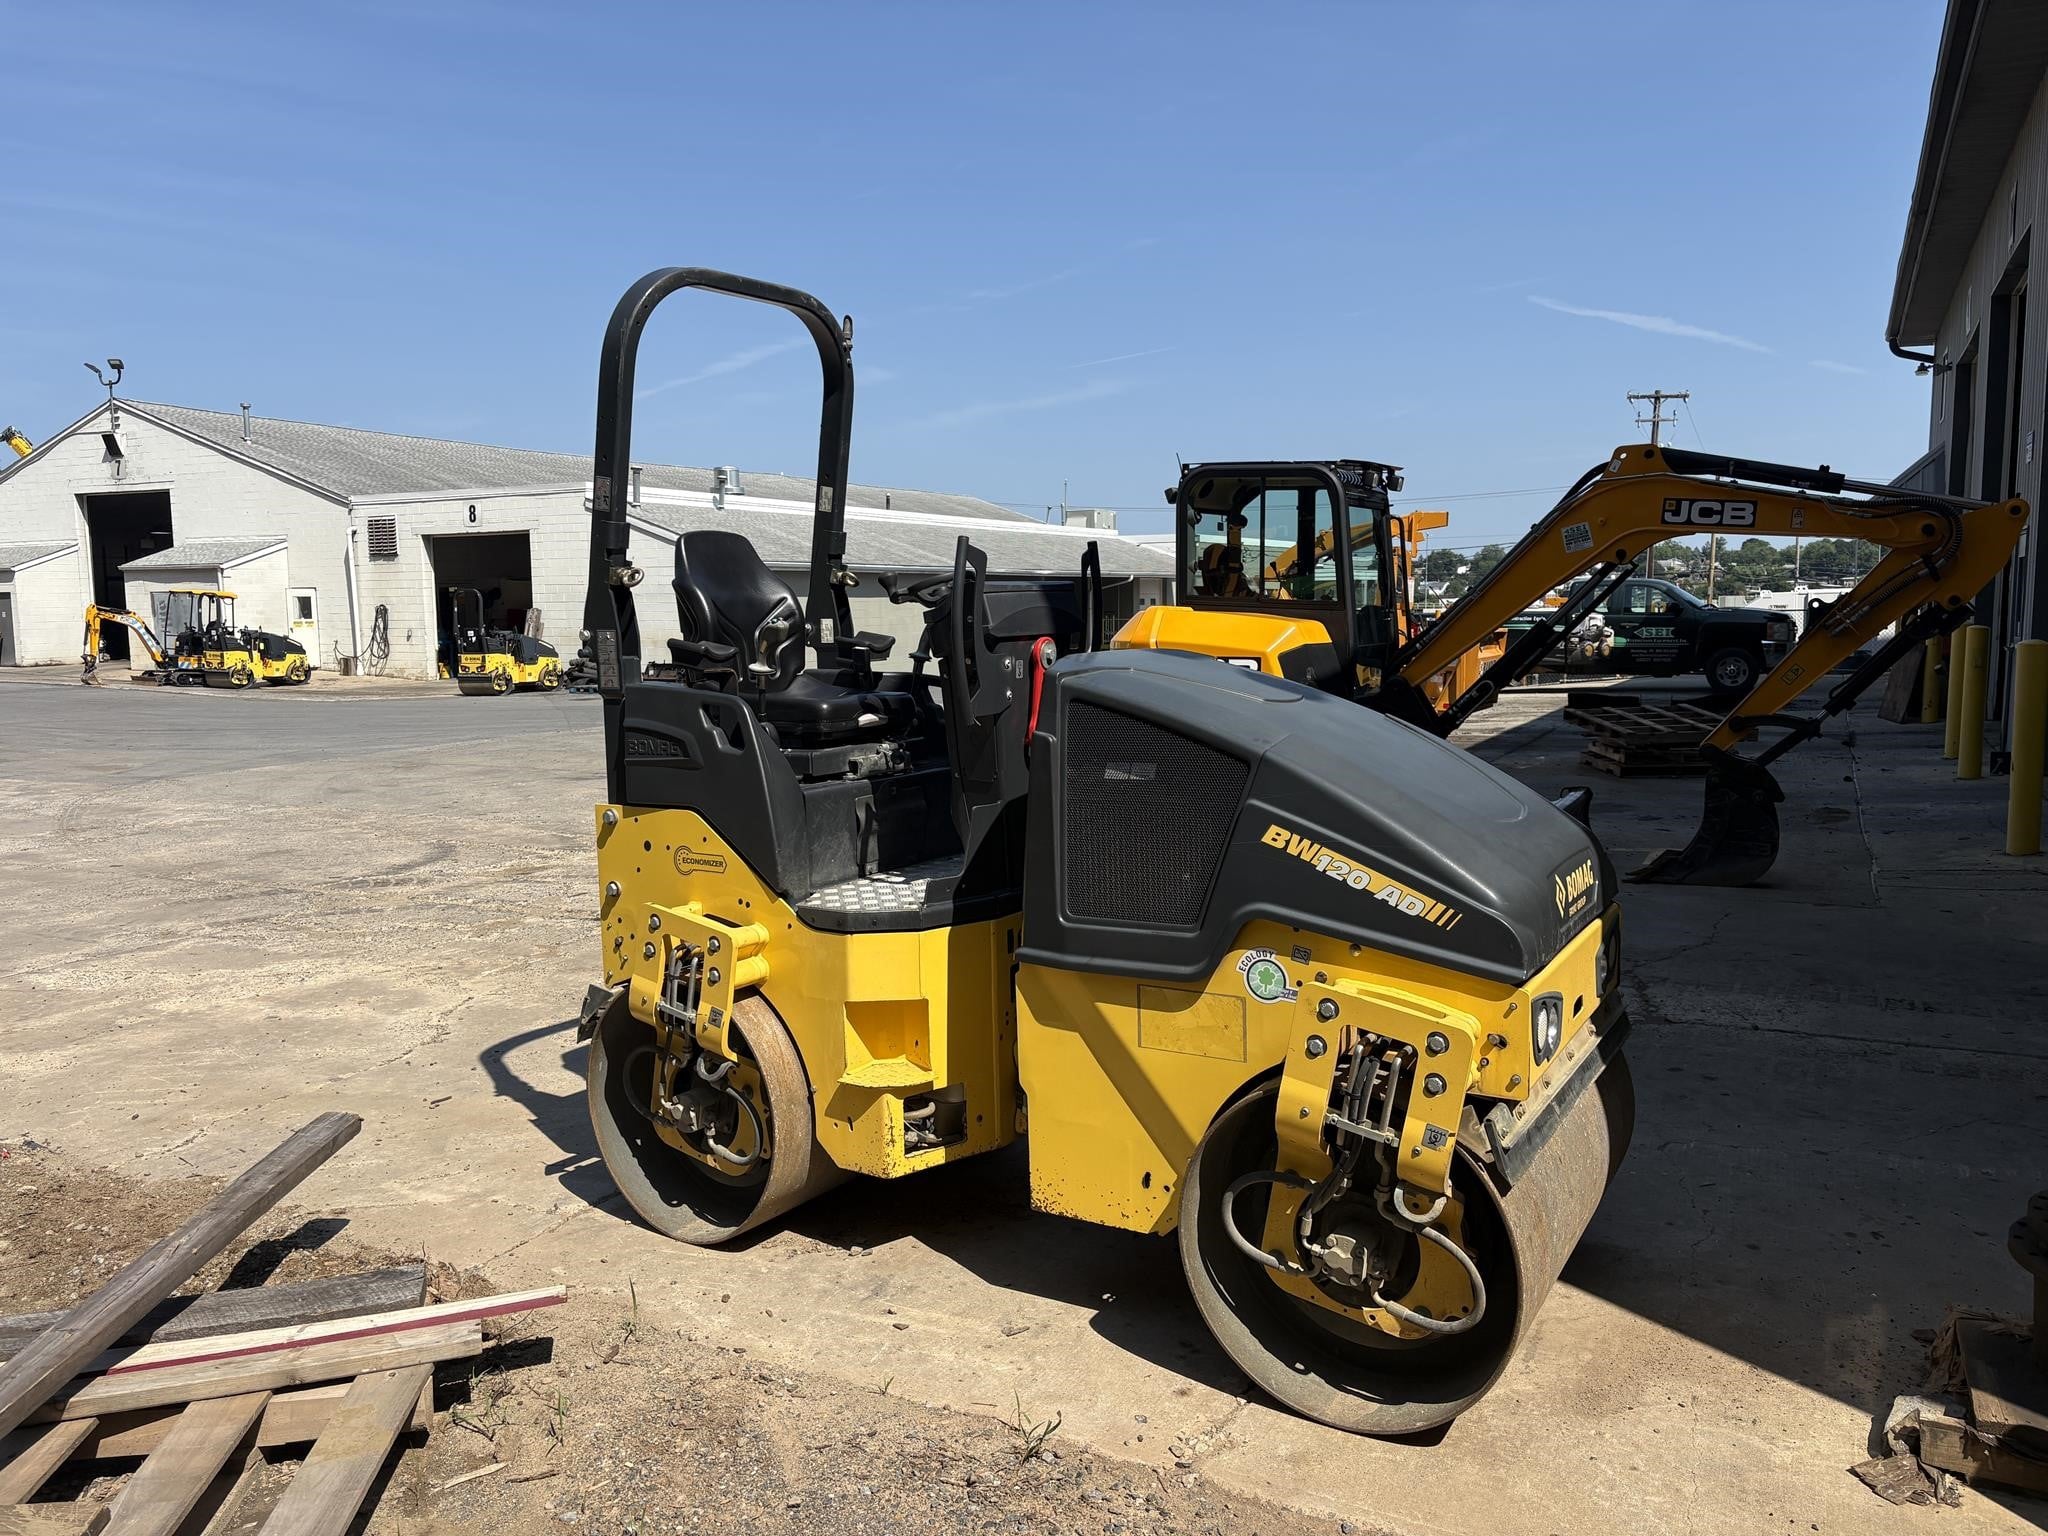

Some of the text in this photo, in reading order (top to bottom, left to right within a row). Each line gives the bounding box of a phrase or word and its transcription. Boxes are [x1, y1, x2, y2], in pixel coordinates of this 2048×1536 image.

[468, 504, 476, 523] 8
[1664, 500, 1754, 526] JCB
[682, 857, 724, 868] ECONOMIZER
[1566, 859, 1594, 902] BOMAG
[1238, 949, 1274, 972] ECOLOGY
